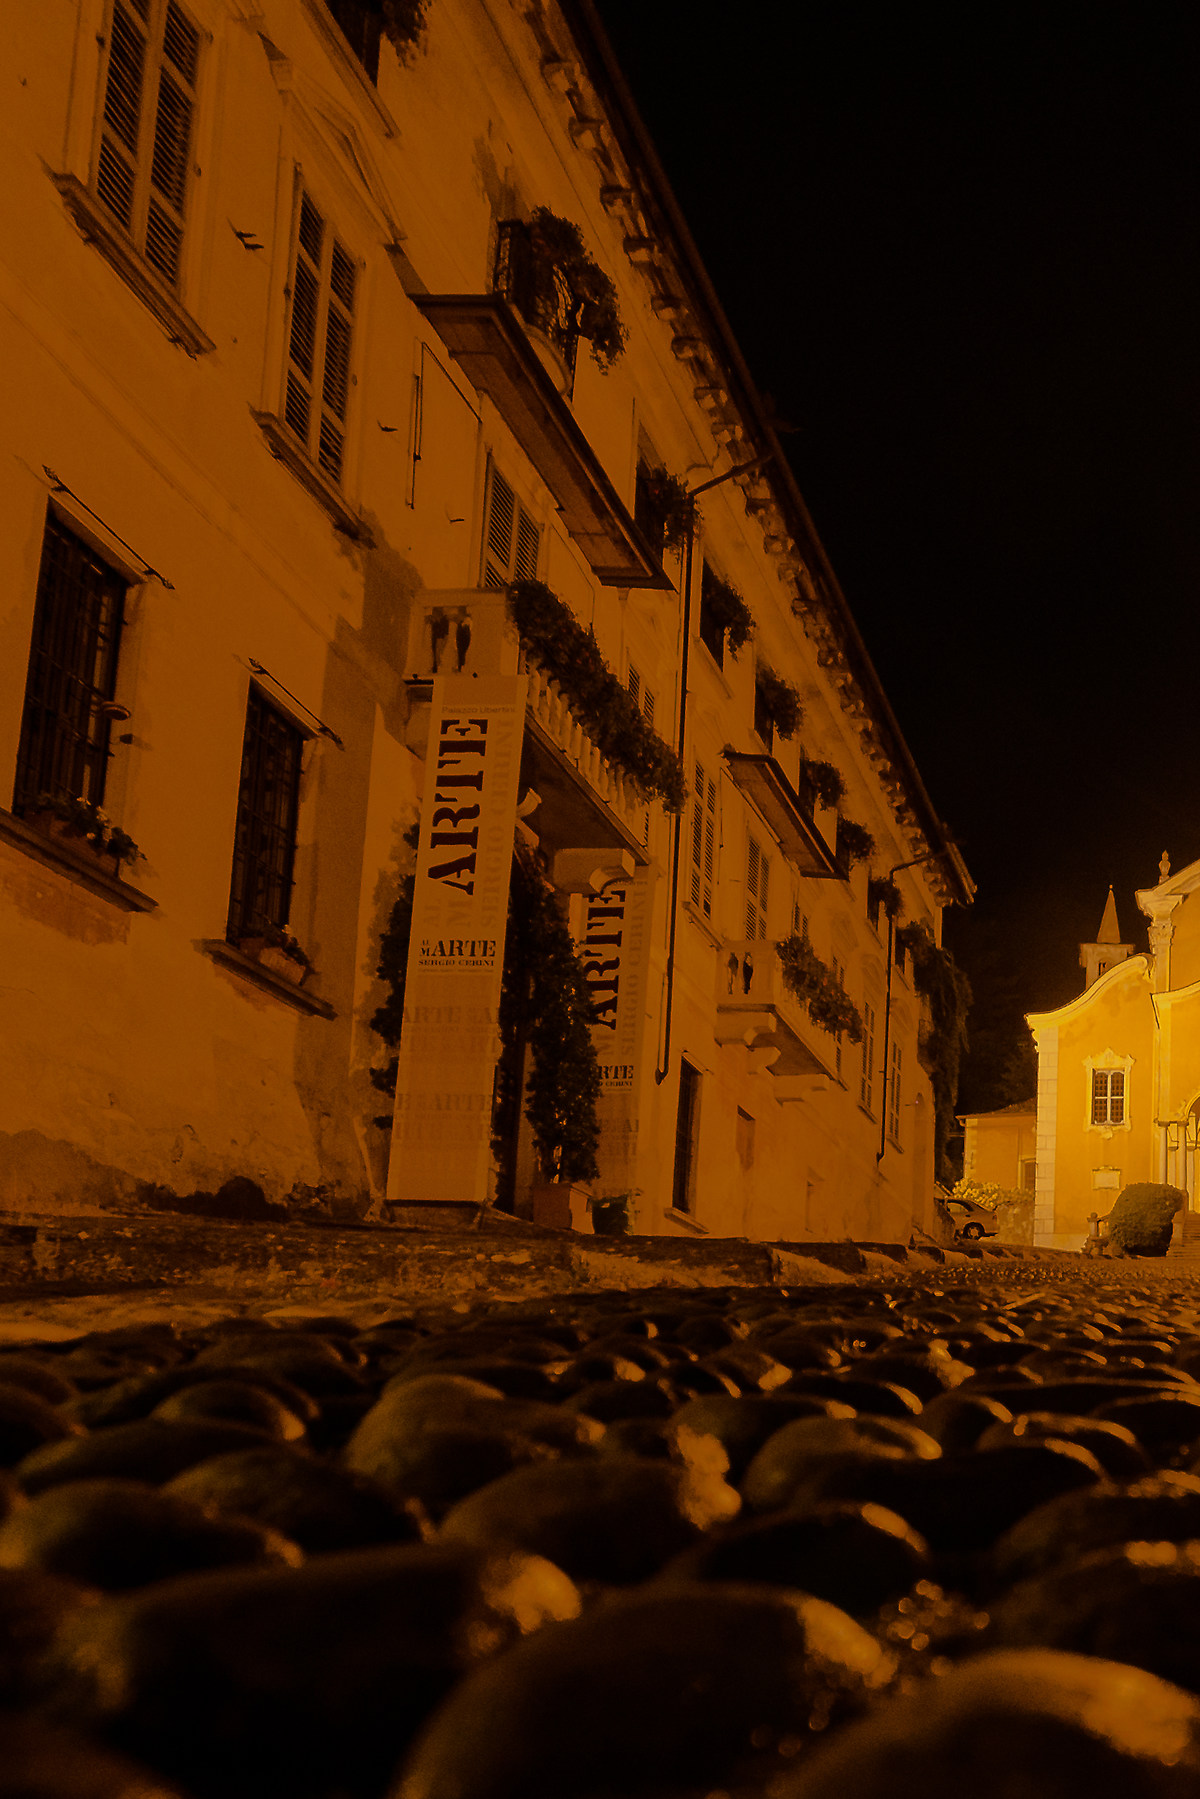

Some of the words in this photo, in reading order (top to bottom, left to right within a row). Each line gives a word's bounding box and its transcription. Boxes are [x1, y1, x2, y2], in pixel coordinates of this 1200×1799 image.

[428, 719, 488, 896] ARTE
[490, 720, 515, 817] CERINI
[480, 825, 505, 928] SERGIO
[418, 959, 455, 967] SERGIO
[458, 959, 494, 967] CERINI
[598, 1065, 634, 1079] RTE
